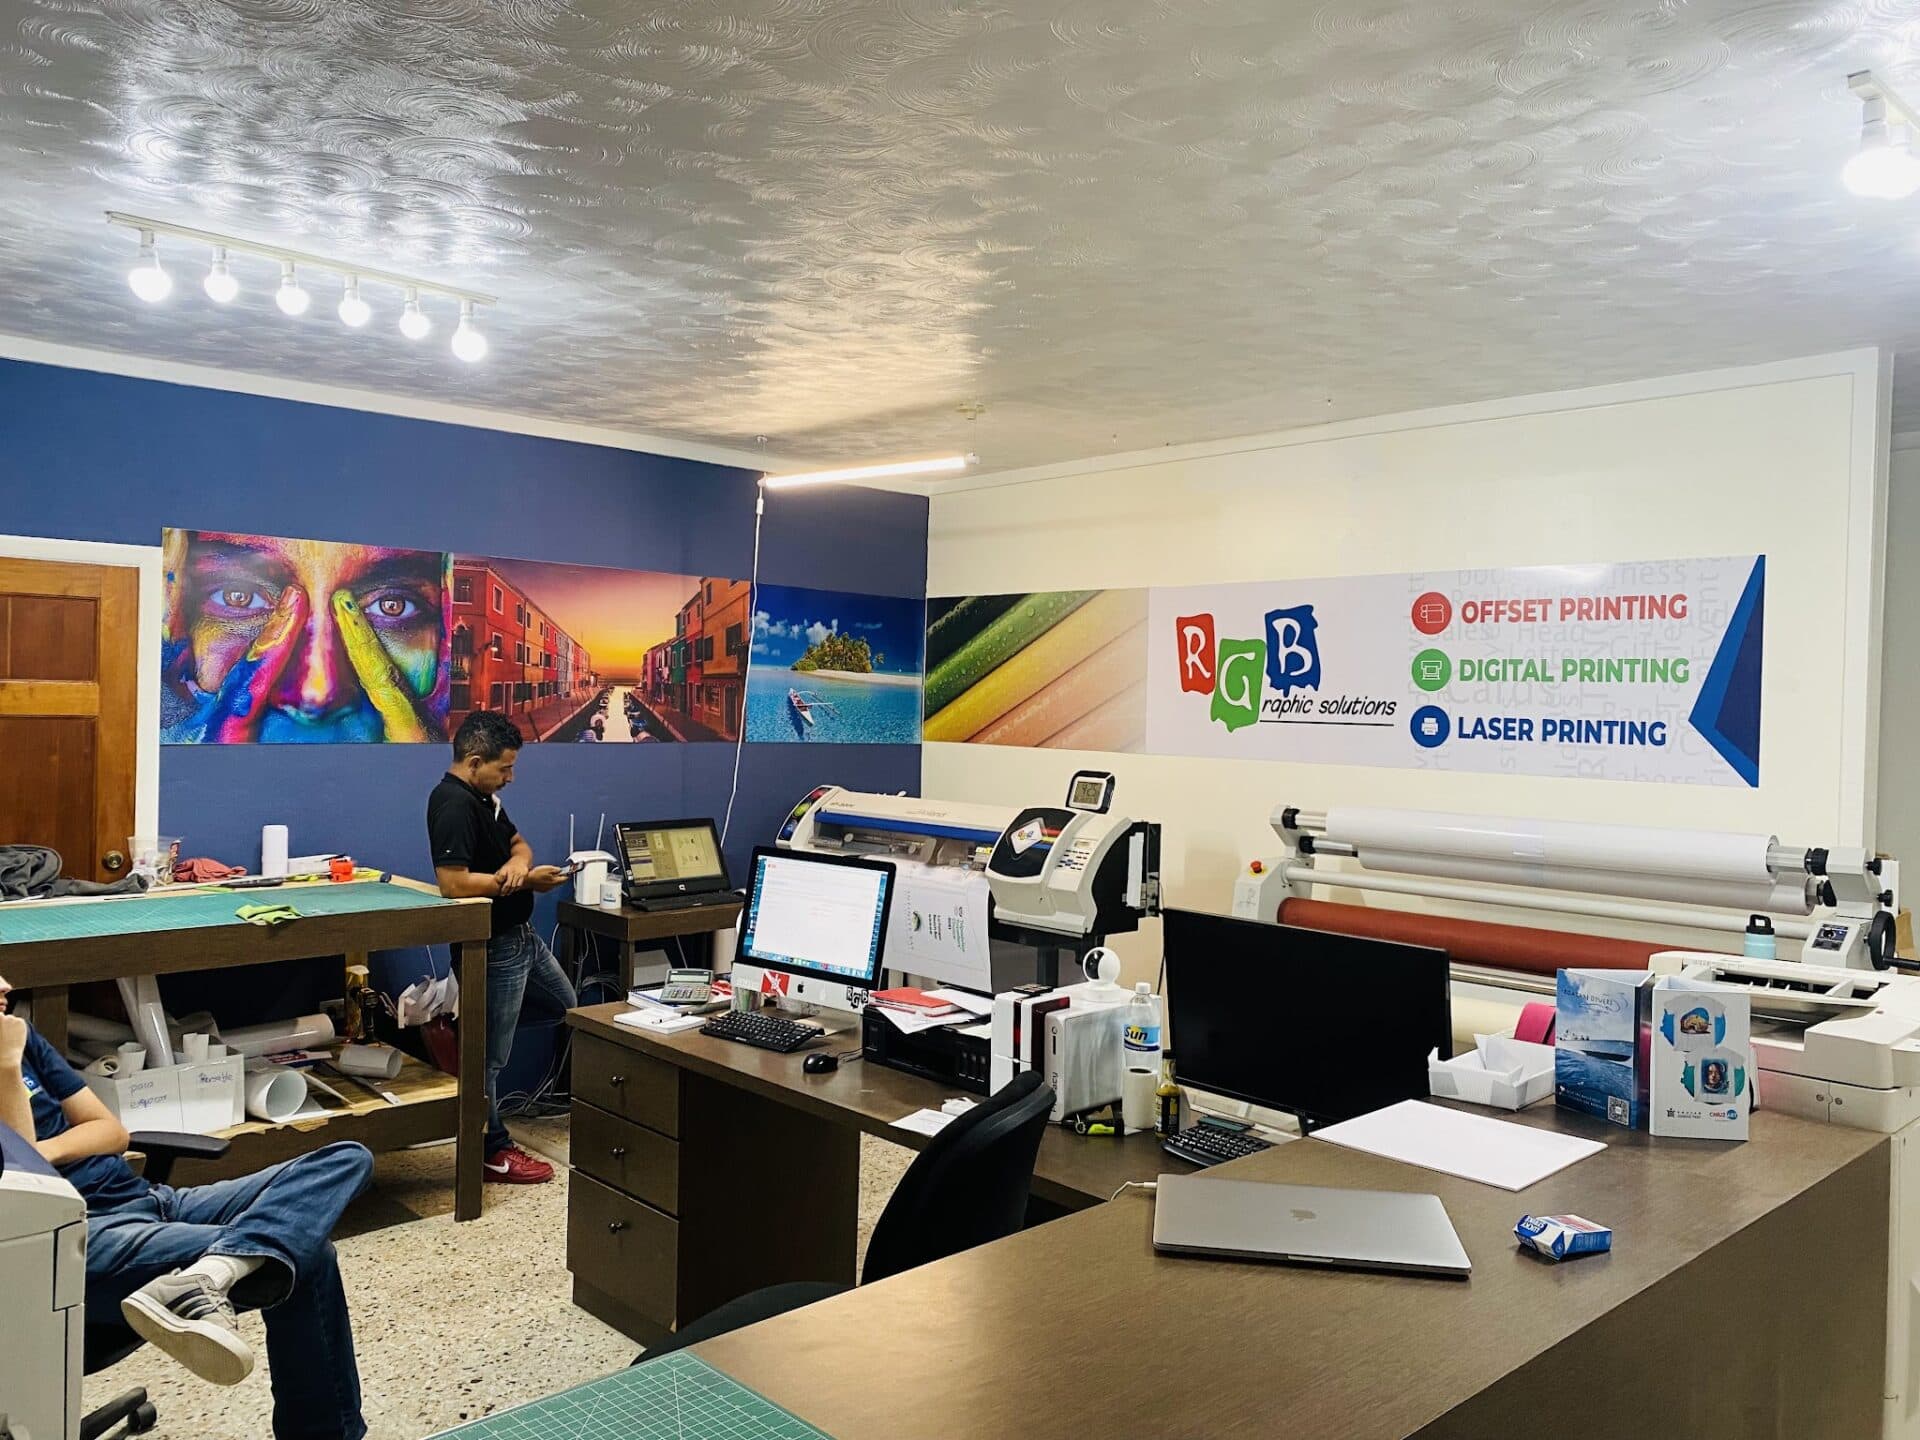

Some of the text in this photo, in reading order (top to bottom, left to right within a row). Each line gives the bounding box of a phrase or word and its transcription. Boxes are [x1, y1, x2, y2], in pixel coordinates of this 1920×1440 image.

[1461, 598, 1553, 624] OFFSET
[1559, 593, 1688, 622] PRINTING
[1459, 657, 1690, 683] DIGITAL PRINTING
[1261, 694, 1397, 719] raphic solutions
[1458, 716, 1667, 747] LASER PRINTING
[1124, 1026, 1148, 1041] Sun
